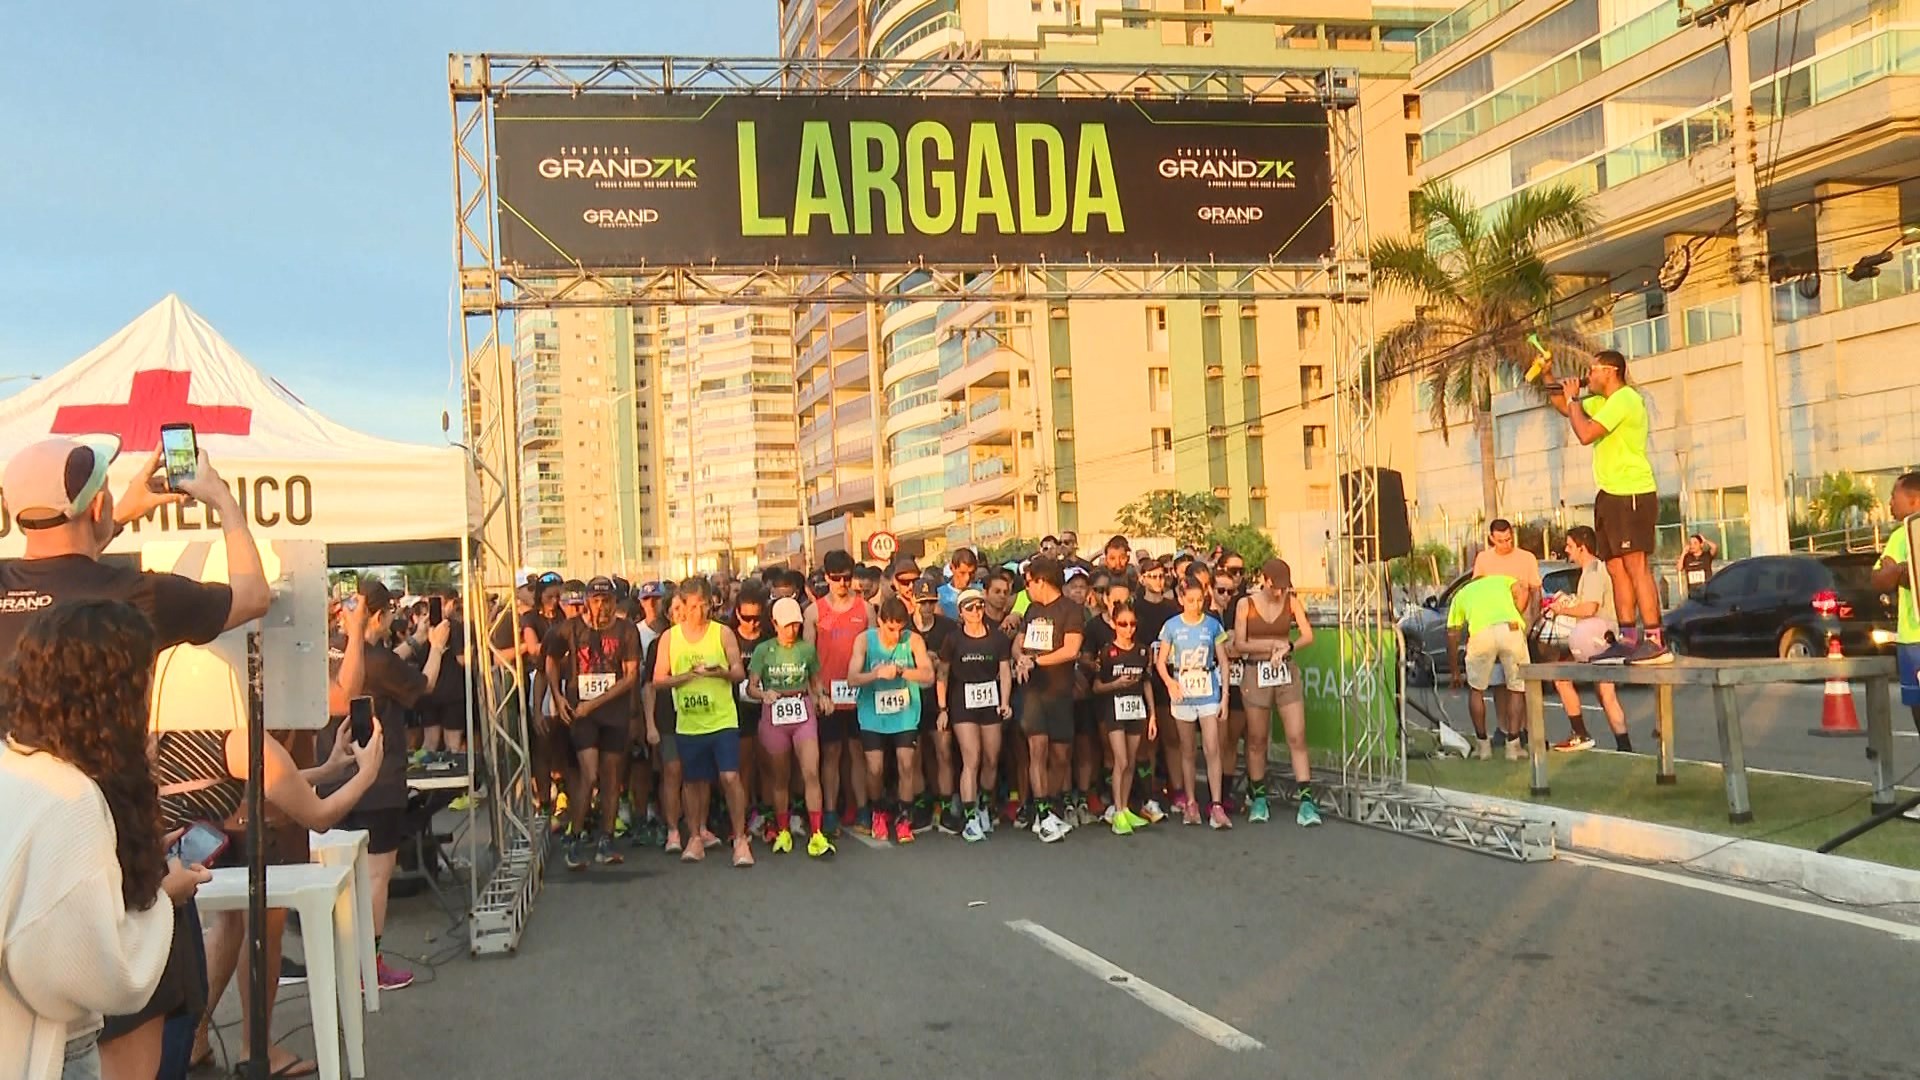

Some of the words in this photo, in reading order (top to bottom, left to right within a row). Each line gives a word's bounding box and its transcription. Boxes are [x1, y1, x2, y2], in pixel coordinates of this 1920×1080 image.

[538, 158, 698, 179] GRAND7K
[1158, 158, 1296, 179] GRAND7K
[737, 120, 1125, 236] LARGADA
[583, 208, 659, 223] GRAND
[1197, 206, 1263, 220] GRAND
[875, 538, 892, 550] 40
[0, 595, 52, 609] RAND
[1030, 631, 1049, 642] 1705
[1262, 665, 1286, 680] 801
[585, 681, 609, 693] 1512
[1185, 677, 1207, 689] 1217
[880, 695, 905, 707] 1419
[971, 687, 993, 701] 1511
[683, 695, 709, 708] 2048
[1119, 700, 1140, 713] 1394
[776, 703, 802, 718] 898
